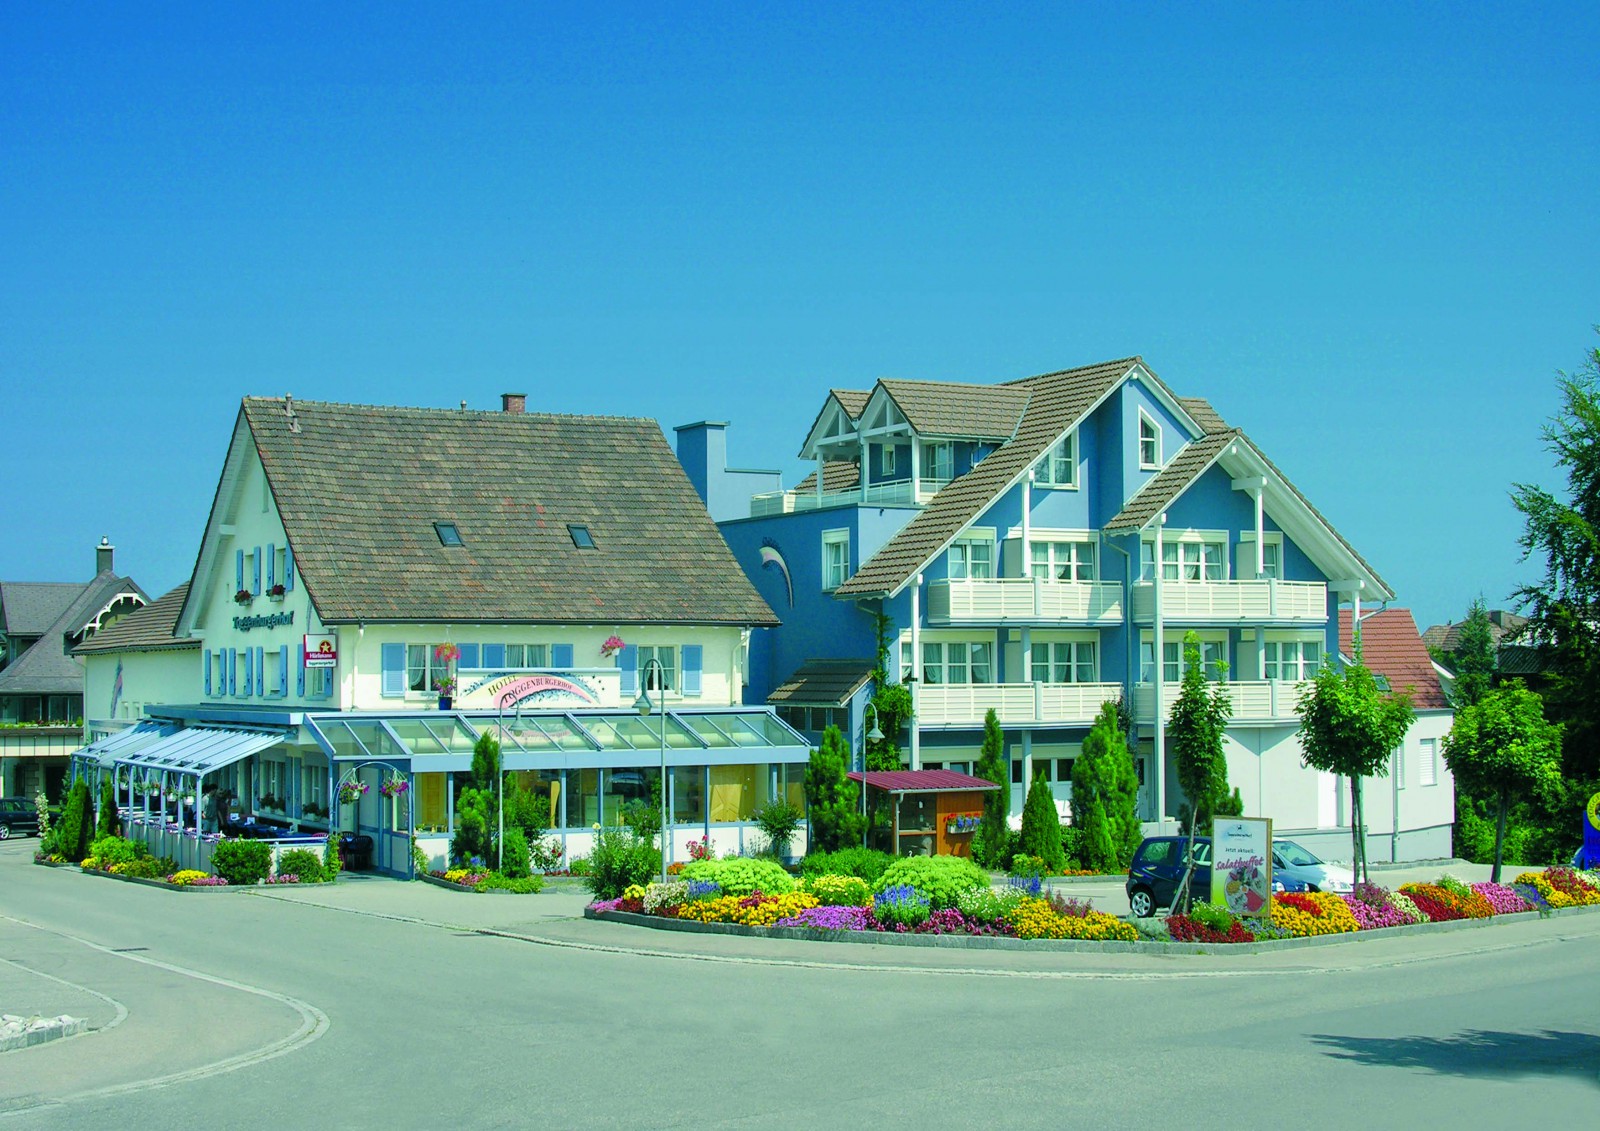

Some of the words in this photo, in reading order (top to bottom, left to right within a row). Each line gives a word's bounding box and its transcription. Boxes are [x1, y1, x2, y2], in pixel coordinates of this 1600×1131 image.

[488, 676, 519, 696] HOTEL
[503, 678, 572, 704] TOGGENBURGERHOF
[1215, 855, 1264, 871] Salatbuffet
